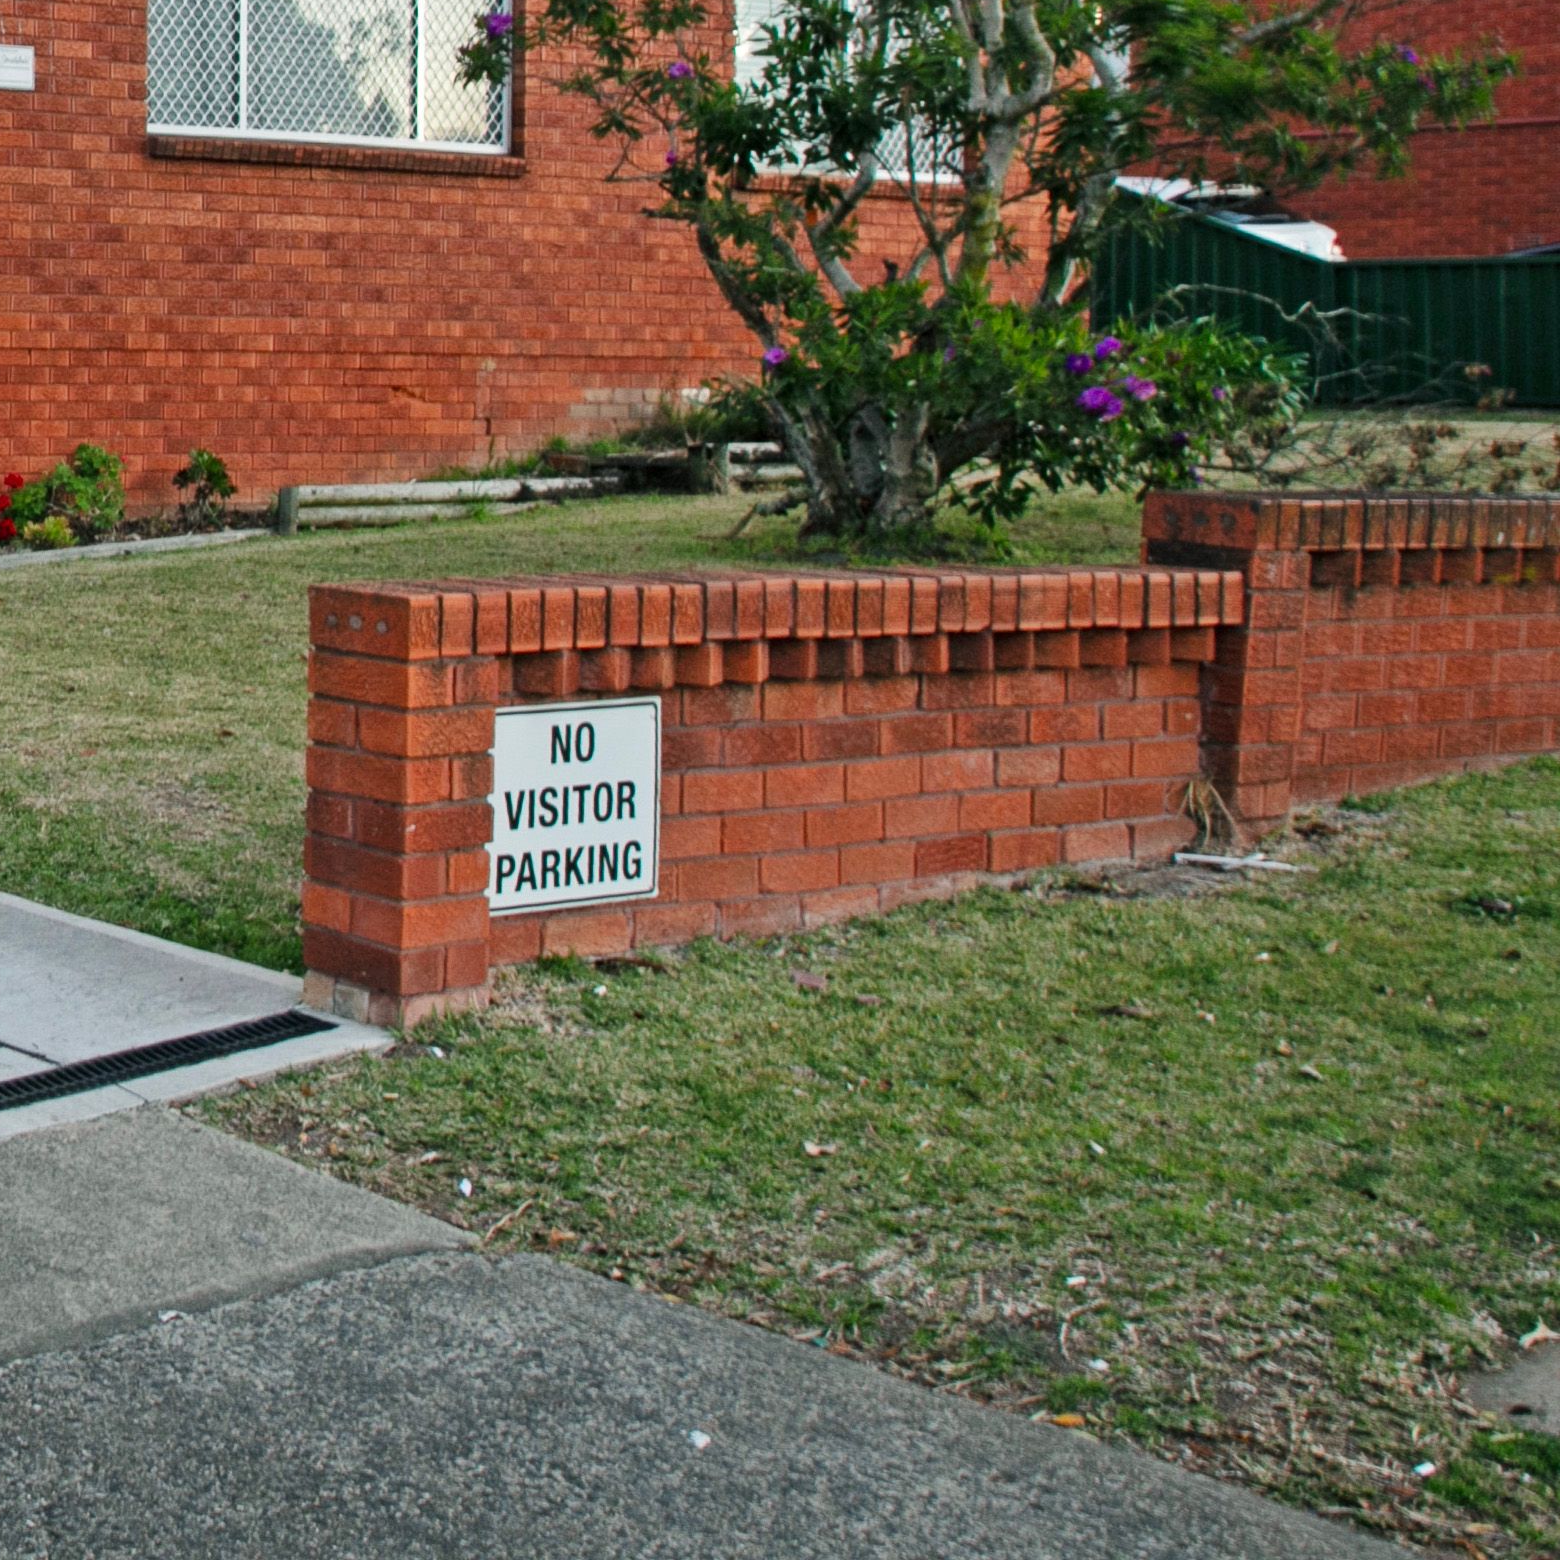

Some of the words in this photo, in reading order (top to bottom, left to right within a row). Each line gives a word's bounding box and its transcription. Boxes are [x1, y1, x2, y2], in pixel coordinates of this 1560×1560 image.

[550, 722, 595, 764] NO
[504, 780, 636, 830] VISITOR
[495, 840, 642, 894] PARKING
